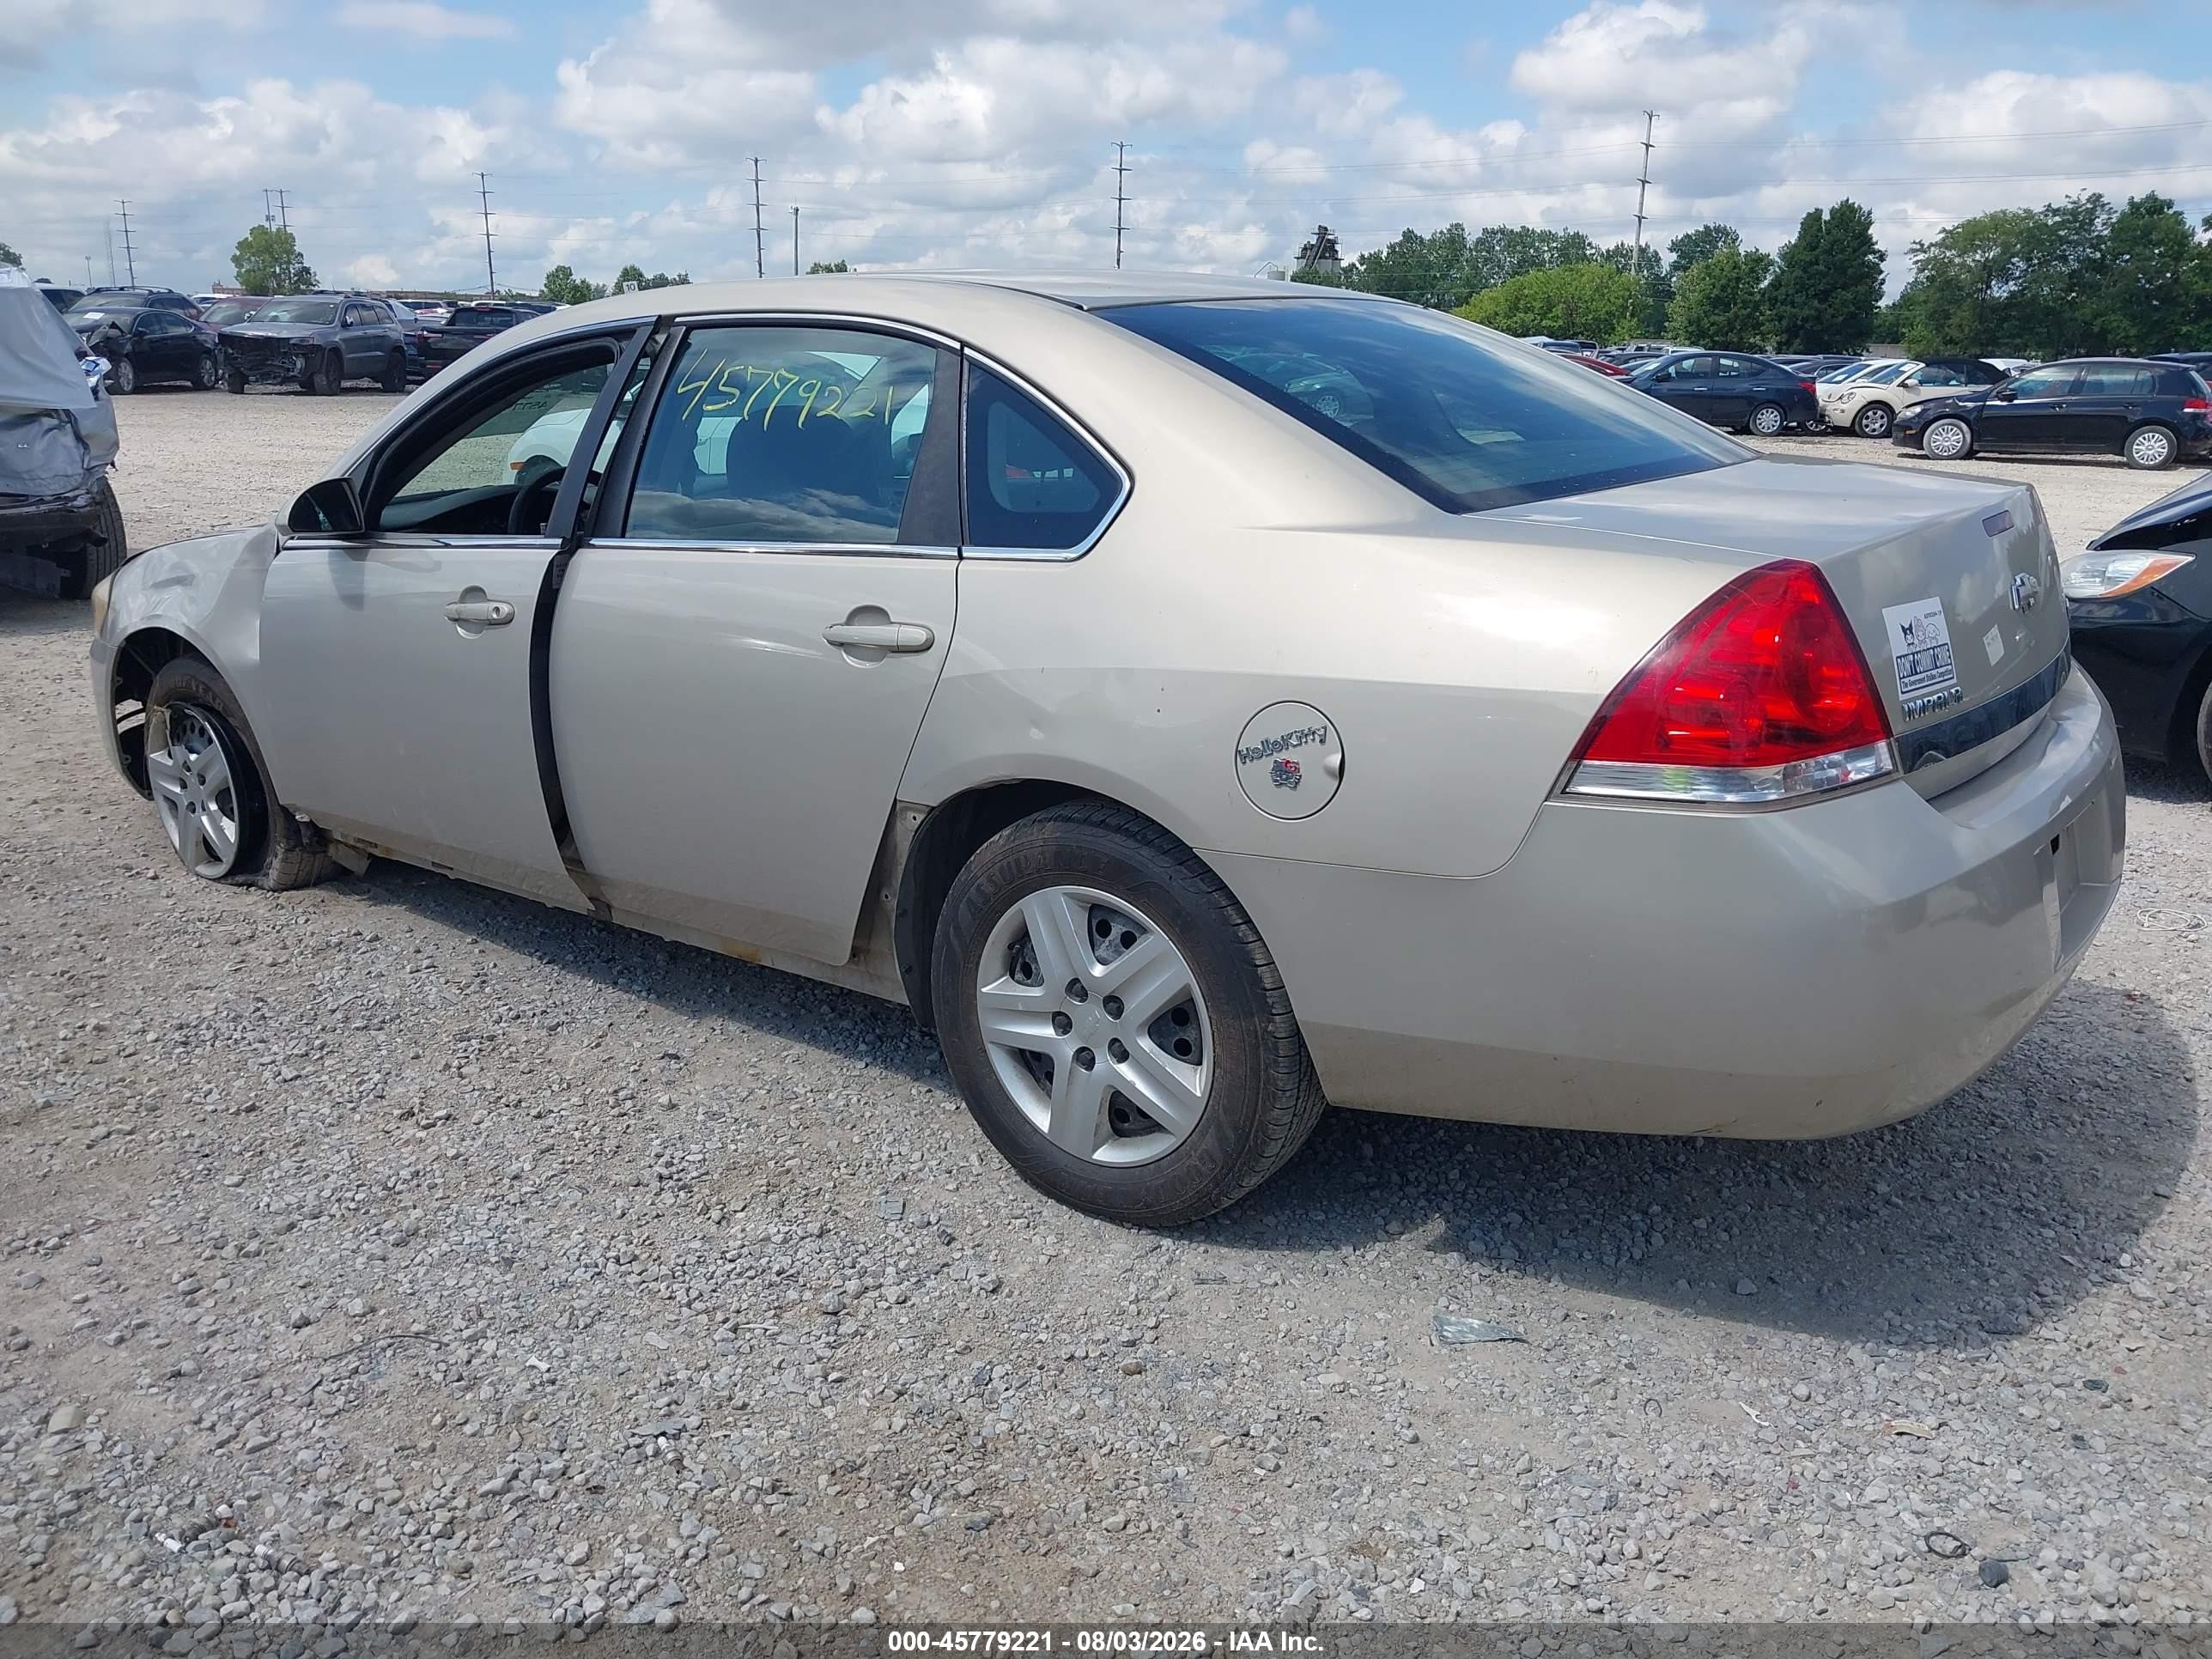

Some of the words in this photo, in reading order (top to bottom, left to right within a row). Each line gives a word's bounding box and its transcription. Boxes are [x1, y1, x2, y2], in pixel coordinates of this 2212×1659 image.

[677, 348, 895, 431] 45779221
[1909, 675, 1926, 687] Government
[1901, 687, 1964, 722] IMPALA
